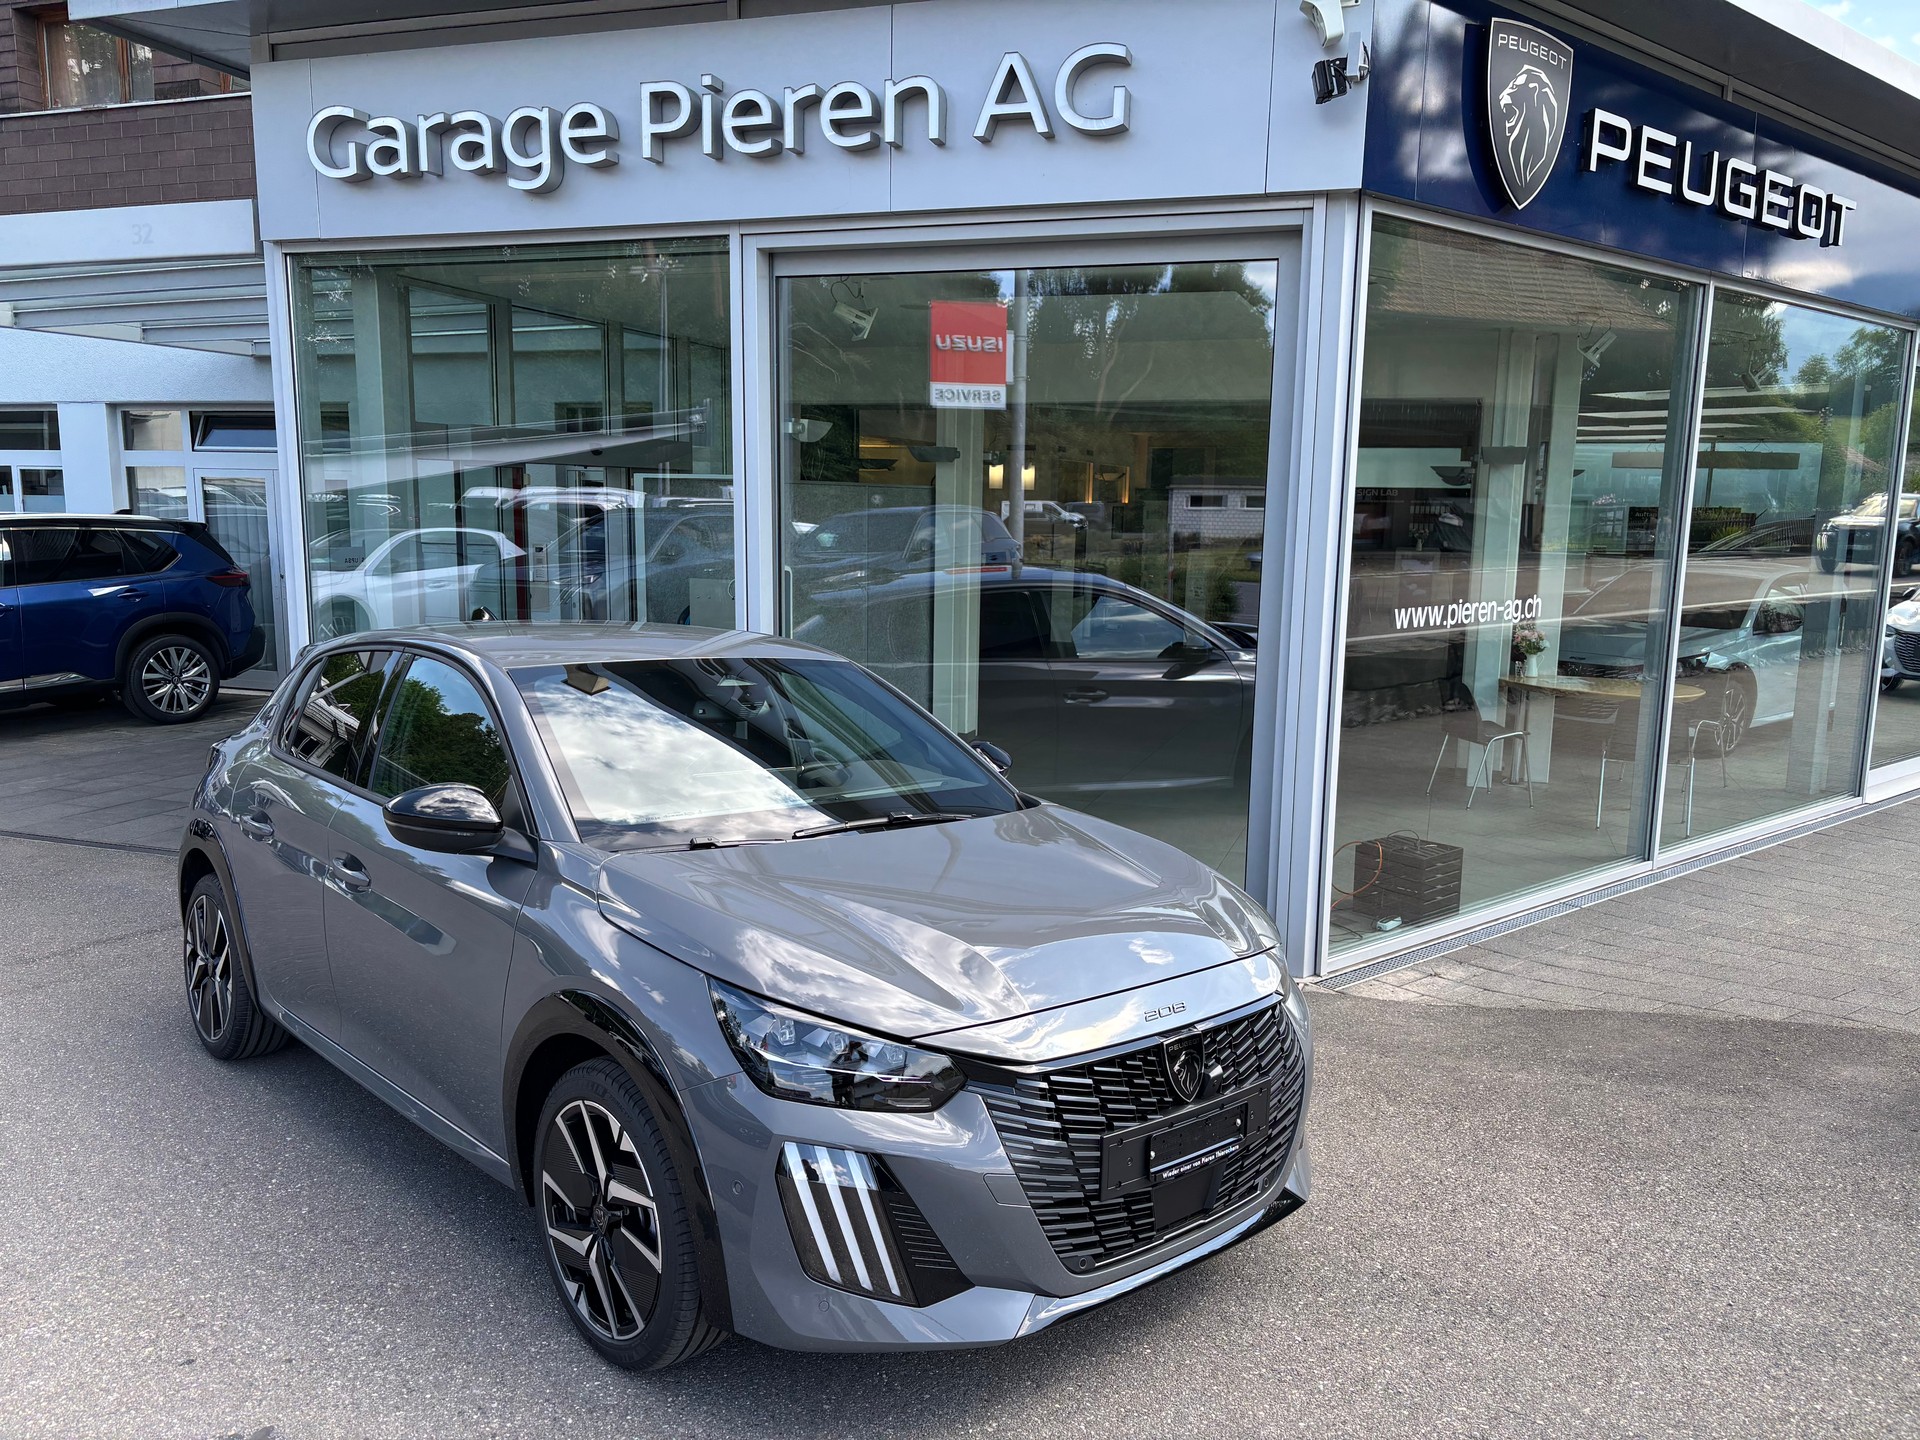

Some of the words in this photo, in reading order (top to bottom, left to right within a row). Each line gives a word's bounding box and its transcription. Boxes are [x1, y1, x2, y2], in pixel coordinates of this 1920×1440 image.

[1498, 34, 1567, 69] PEUGEOT
[306, 101, 619, 194] Garage
[640, 73, 946, 163] Pieren
[973, 42, 1133, 139] AG
[1588, 108, 1857, 247] PEUGEOT
[131, 223, 155, 245] 32
[1356, 488, 1379, 497] SIGN
[1380, 489, 1399, 497] LAB
[1394, 594, 1542, 629] www.pieren-ag.ch
[1143, 1000, 1187, 1022] 208
[1168, 1037, 1201, 1053] PEUGEOT
[1162, 1167, 1180, 1179] Wieder
